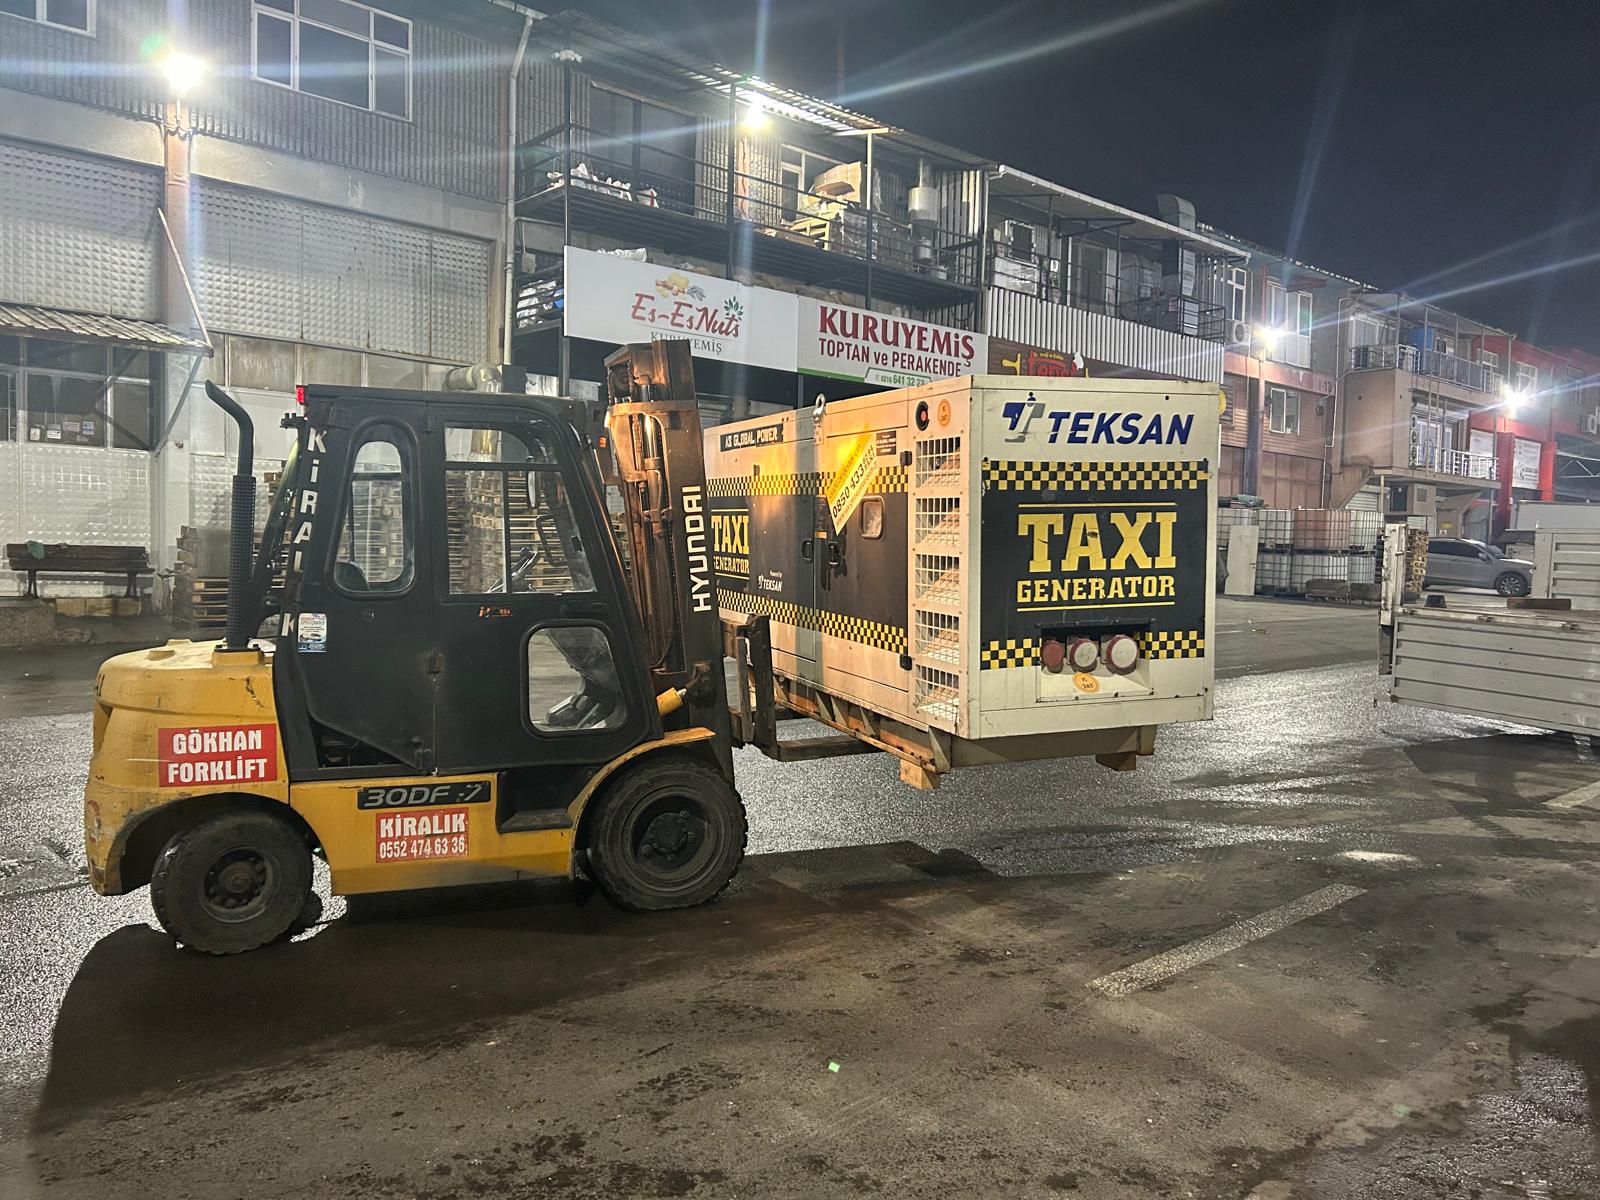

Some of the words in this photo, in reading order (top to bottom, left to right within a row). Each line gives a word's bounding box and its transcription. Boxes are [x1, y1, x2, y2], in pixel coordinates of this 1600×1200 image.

[819, 338, 870, 364] TOPTAN
[874, 352, 888, 366] ve
[891, 352, 962, 377] PERAKENDE
[725, 435, 733, 448] AS
[733, 431, 756, 447] GLOBAL
[756, 427, 778, 443] POWER
[1048, 412, 1195, 444] TEKSAN
[832, 486, 850, 518] 0850
[682, 485, 712, 612] HYUNDAI
[711, 515, 750, 554] TAXI
[1018, 511, 1177, 572] TAXI
[1017, 575, 1175, 603] GENERATOR
[172, 729, 262, 755] GÖKHAN
[168, 756, 267, 783] FORKLİFT
[380, 813, 465, 839] KİRALIK
[380, 841, 407, 859] 0552
[411, 839, 432, 858] 474
[434, 838, 449, 855] 63
[452, 836, 465, 854] 36
